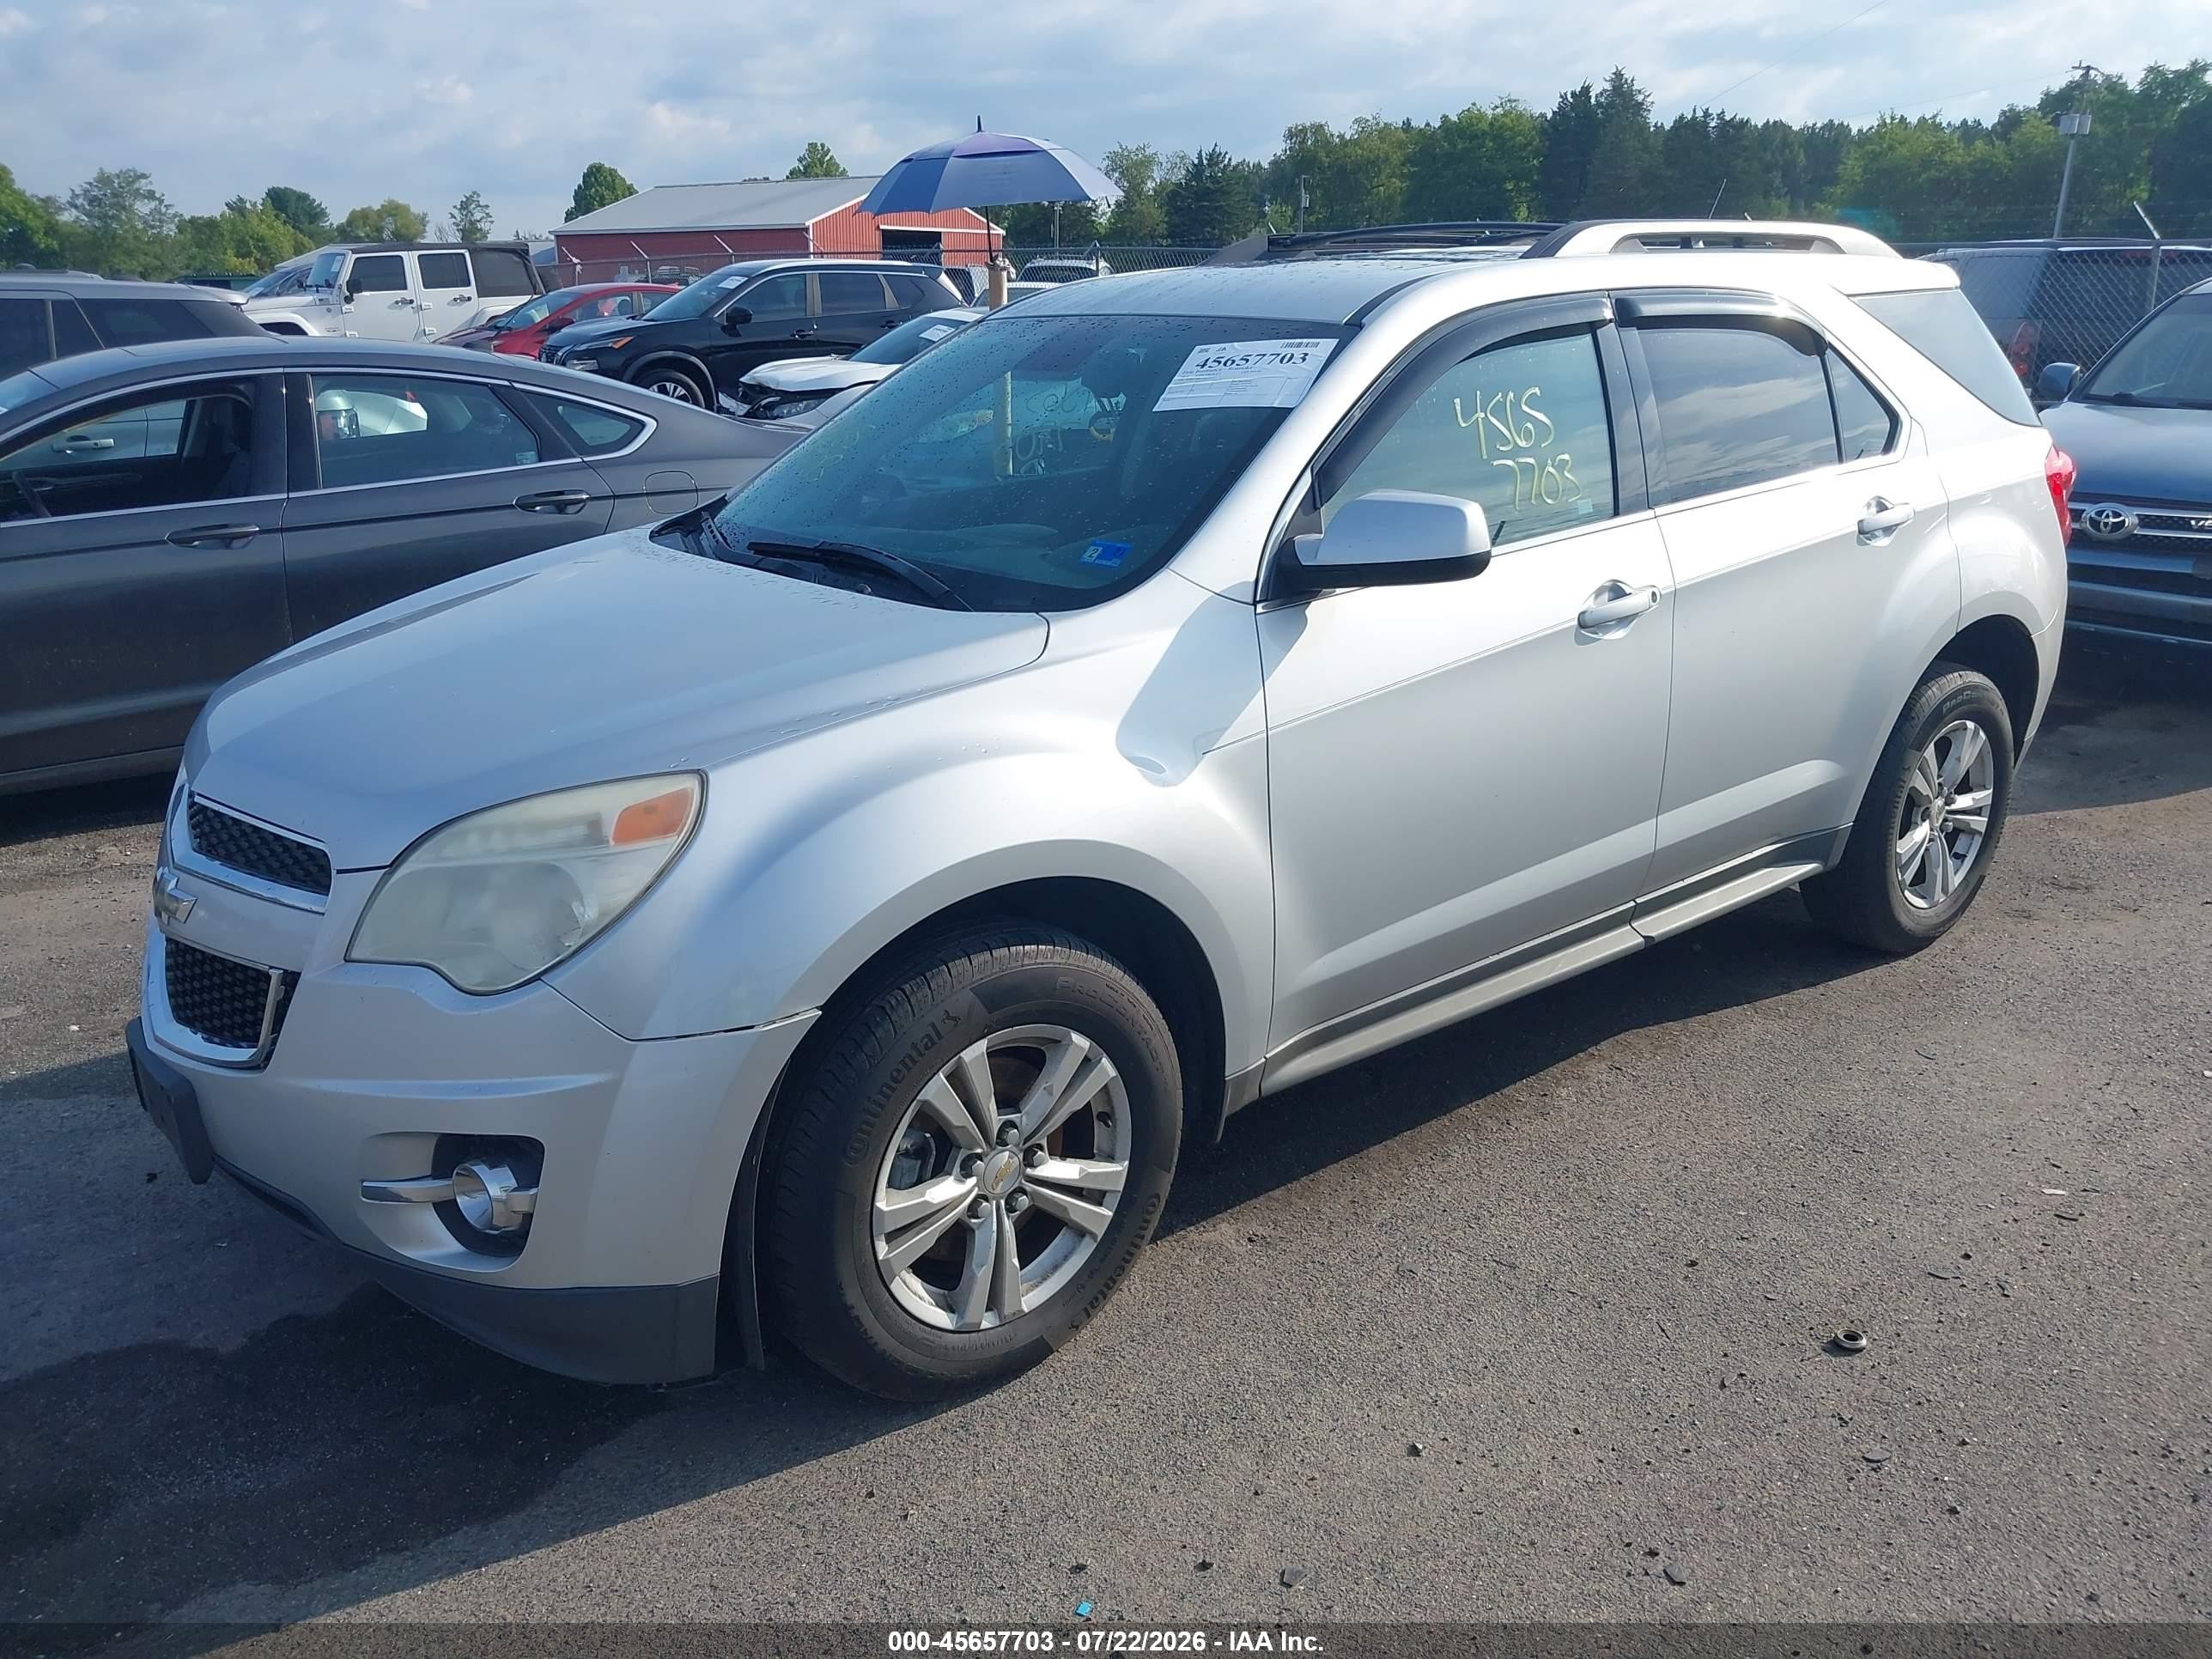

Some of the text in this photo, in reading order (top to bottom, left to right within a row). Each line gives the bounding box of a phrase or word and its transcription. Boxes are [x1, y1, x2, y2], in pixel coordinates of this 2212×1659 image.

[1195, 351, 1309, 370] 45657703
[1453, 386, 1556, 459] 4565
[1491, 453, 1583, 511] 7703
